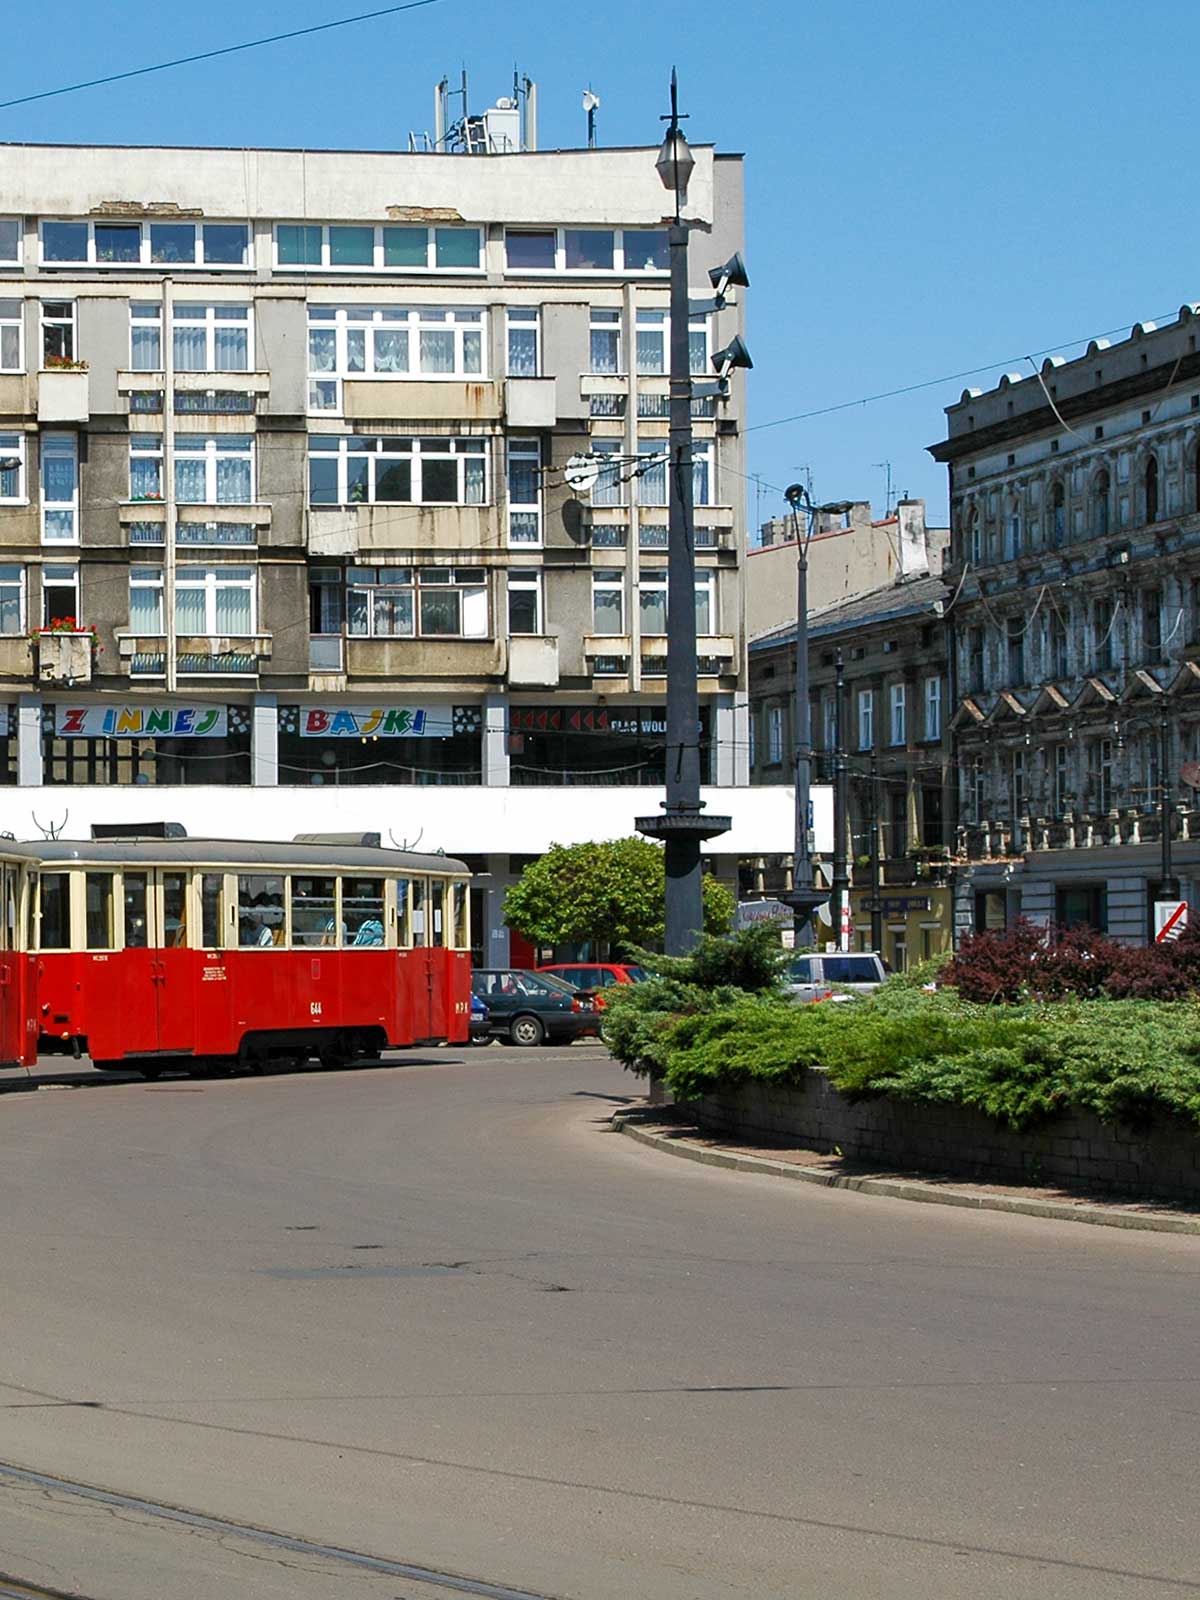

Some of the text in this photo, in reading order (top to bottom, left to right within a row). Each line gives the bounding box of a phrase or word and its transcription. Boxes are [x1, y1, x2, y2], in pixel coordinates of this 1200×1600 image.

[61, 709, 89, 735] Z
[102, 708, 221, 736] INNEJ
[306, 709, 427, 736] BAJKI
[310, 1001, 322, 1015] 644
